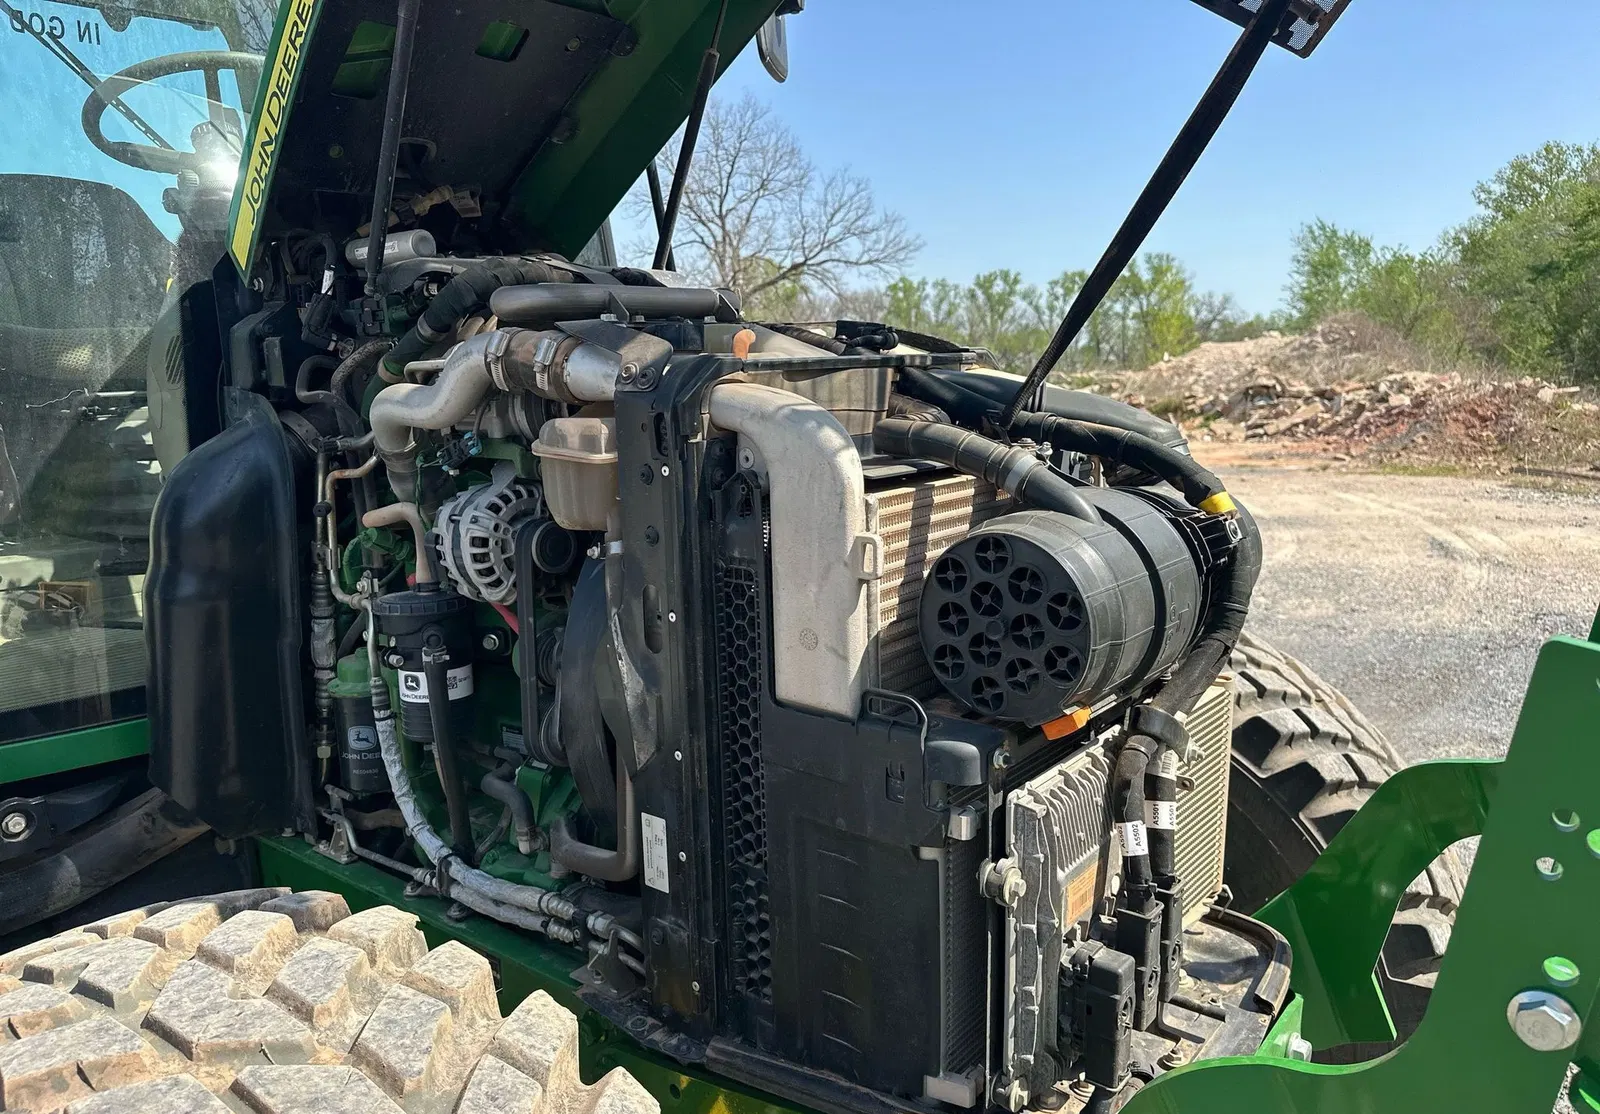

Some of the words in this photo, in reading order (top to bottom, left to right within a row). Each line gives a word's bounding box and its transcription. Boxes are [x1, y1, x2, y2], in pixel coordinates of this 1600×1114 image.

[245, 127, 276, 225] JOHN
[267, 0, 311, 128] DEERE
[1132, 824, 1141, 847] A5502
